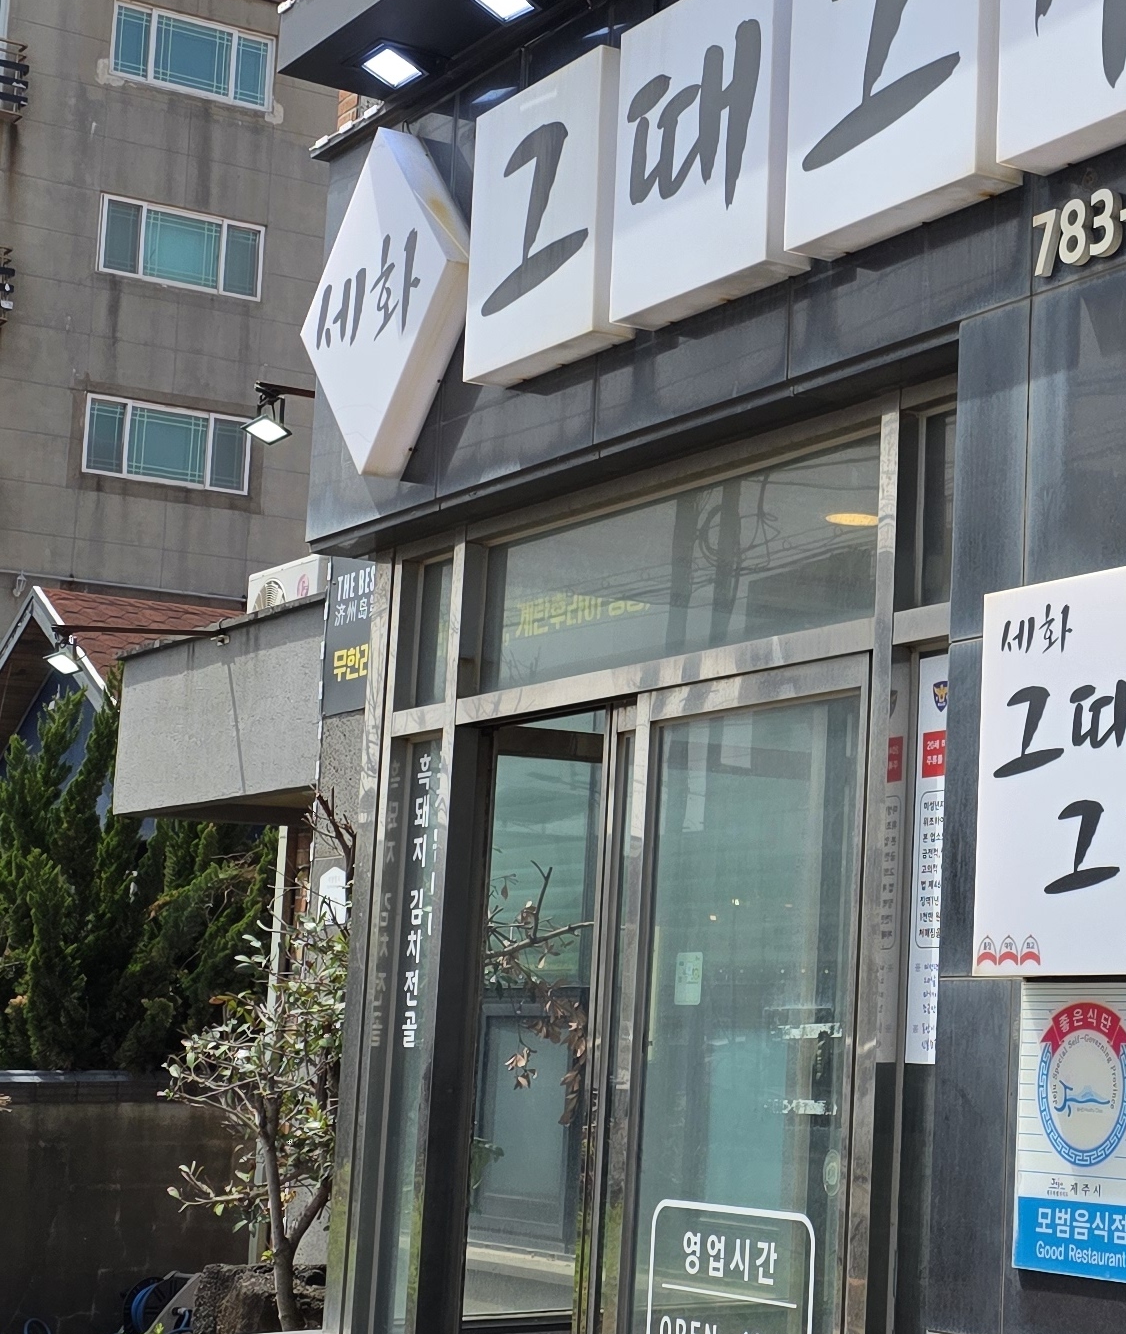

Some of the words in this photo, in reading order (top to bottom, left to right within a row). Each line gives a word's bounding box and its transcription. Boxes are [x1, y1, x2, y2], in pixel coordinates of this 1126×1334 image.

[316, 224, 421, 351] 세화
[337, 571, 356, 602] THE
[1000, 603, 1073, 654] 세화
[412, 753, 432, 867] 흑돼지
[401, 888, 424, 1048] 김치전골
[1058, 1008, 1112, 1033] 좋은식단
[1053, 1047, 1068, 1080] Special
[1110, 1065, 1118, 1110] Province
[682, 1230, 778, 1286] 영업시간
[1036, 1240, 1065, 1261] Good
[1068, 1243, 1126, 1269] Restaurant
